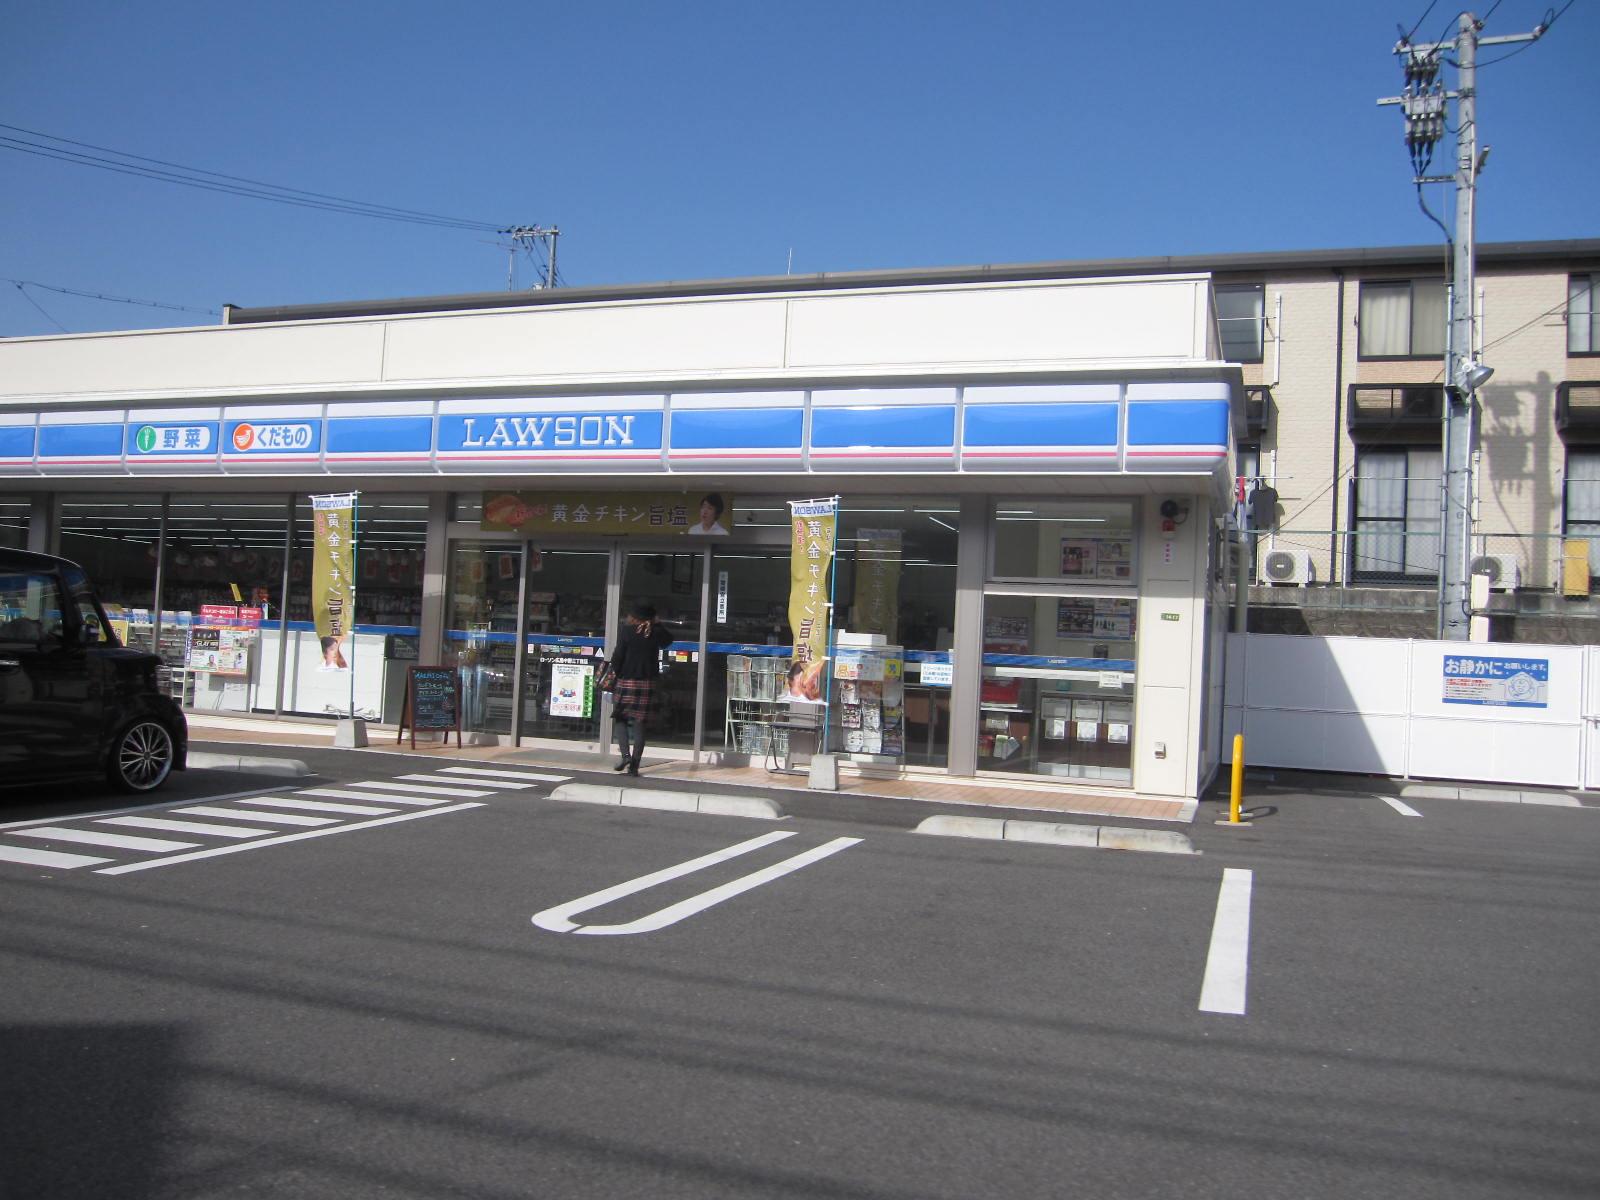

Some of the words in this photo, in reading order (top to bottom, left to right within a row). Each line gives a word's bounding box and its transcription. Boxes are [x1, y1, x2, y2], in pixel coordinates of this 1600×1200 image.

[163, 428, 202, 449] 野菜
[257, 424, 308, 447] くだもの
[462, 415, 635, 447] LAWSON
[552, 503, 689, 526] 黄金チキン旨塩
[1444, 658, 1504, 675] お静かに
